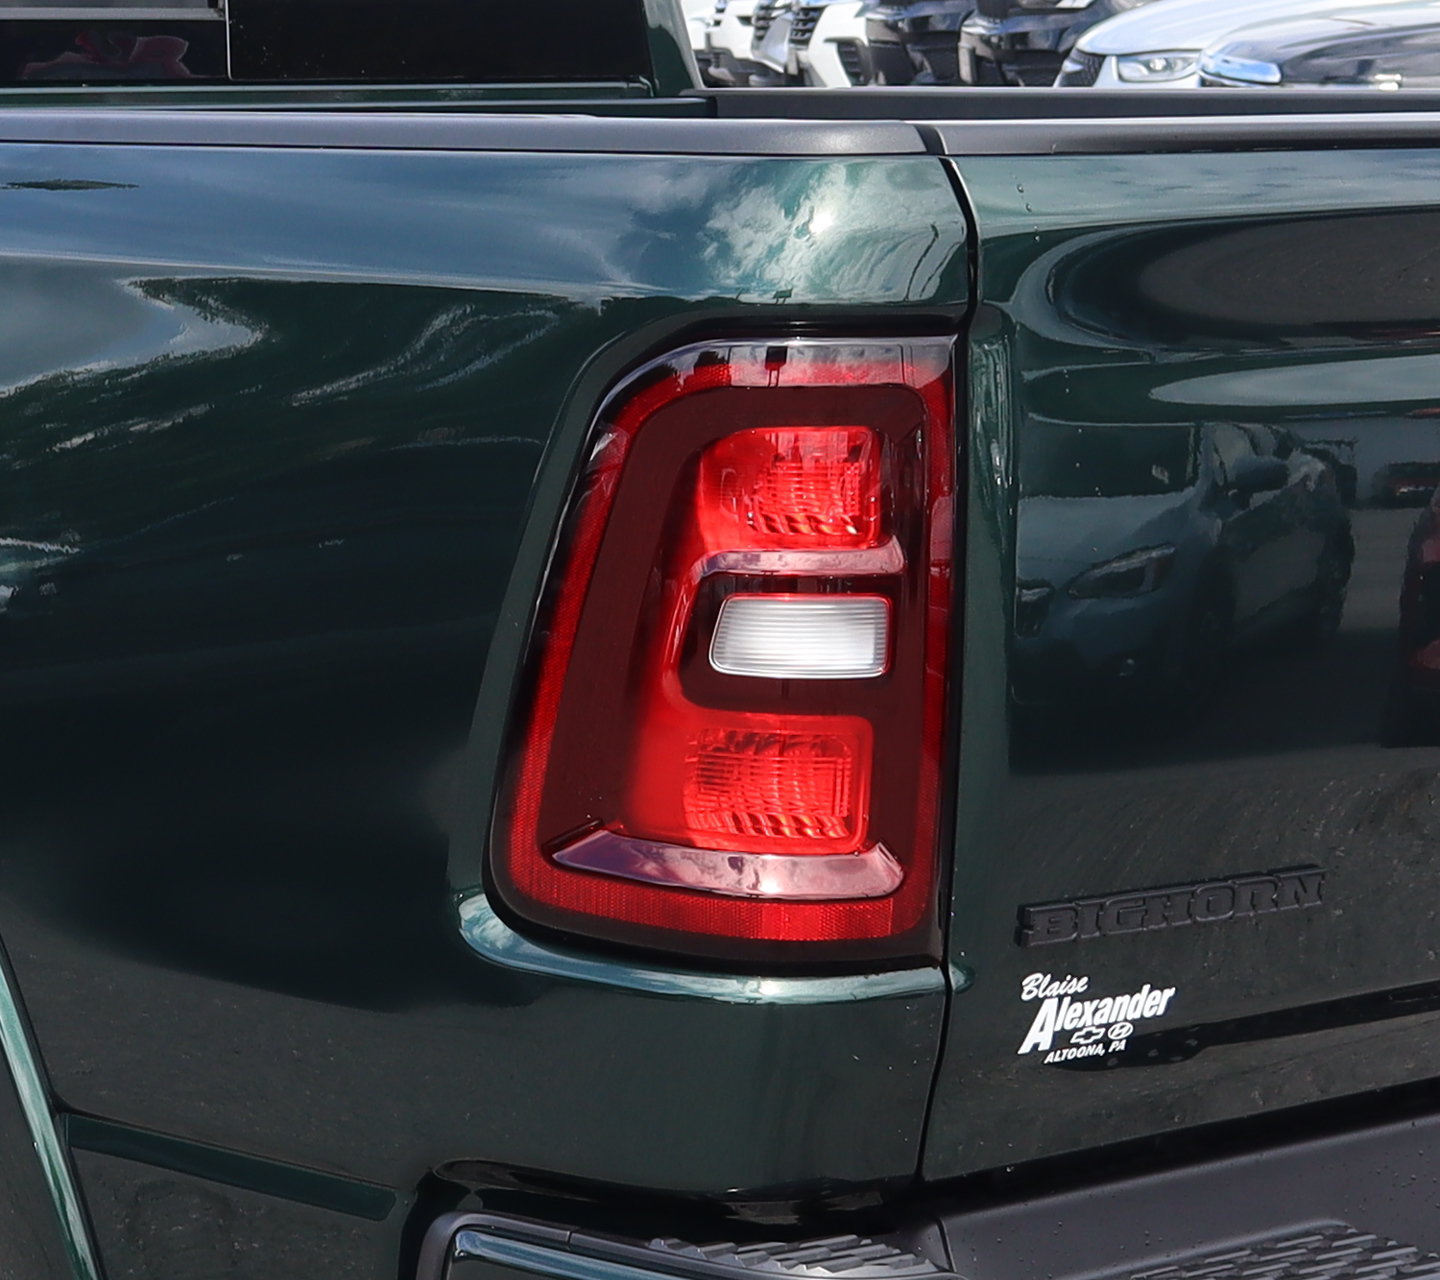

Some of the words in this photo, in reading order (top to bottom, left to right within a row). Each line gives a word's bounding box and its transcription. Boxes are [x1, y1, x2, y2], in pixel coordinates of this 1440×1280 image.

[1021, 972, 1089, 1001] Blaise
[1018, 984, 1176, 1055] Alexander
[1044, 1042, 1105, 1064] ALTOONA,
[1108, 1038, 1127, 1052] PA
